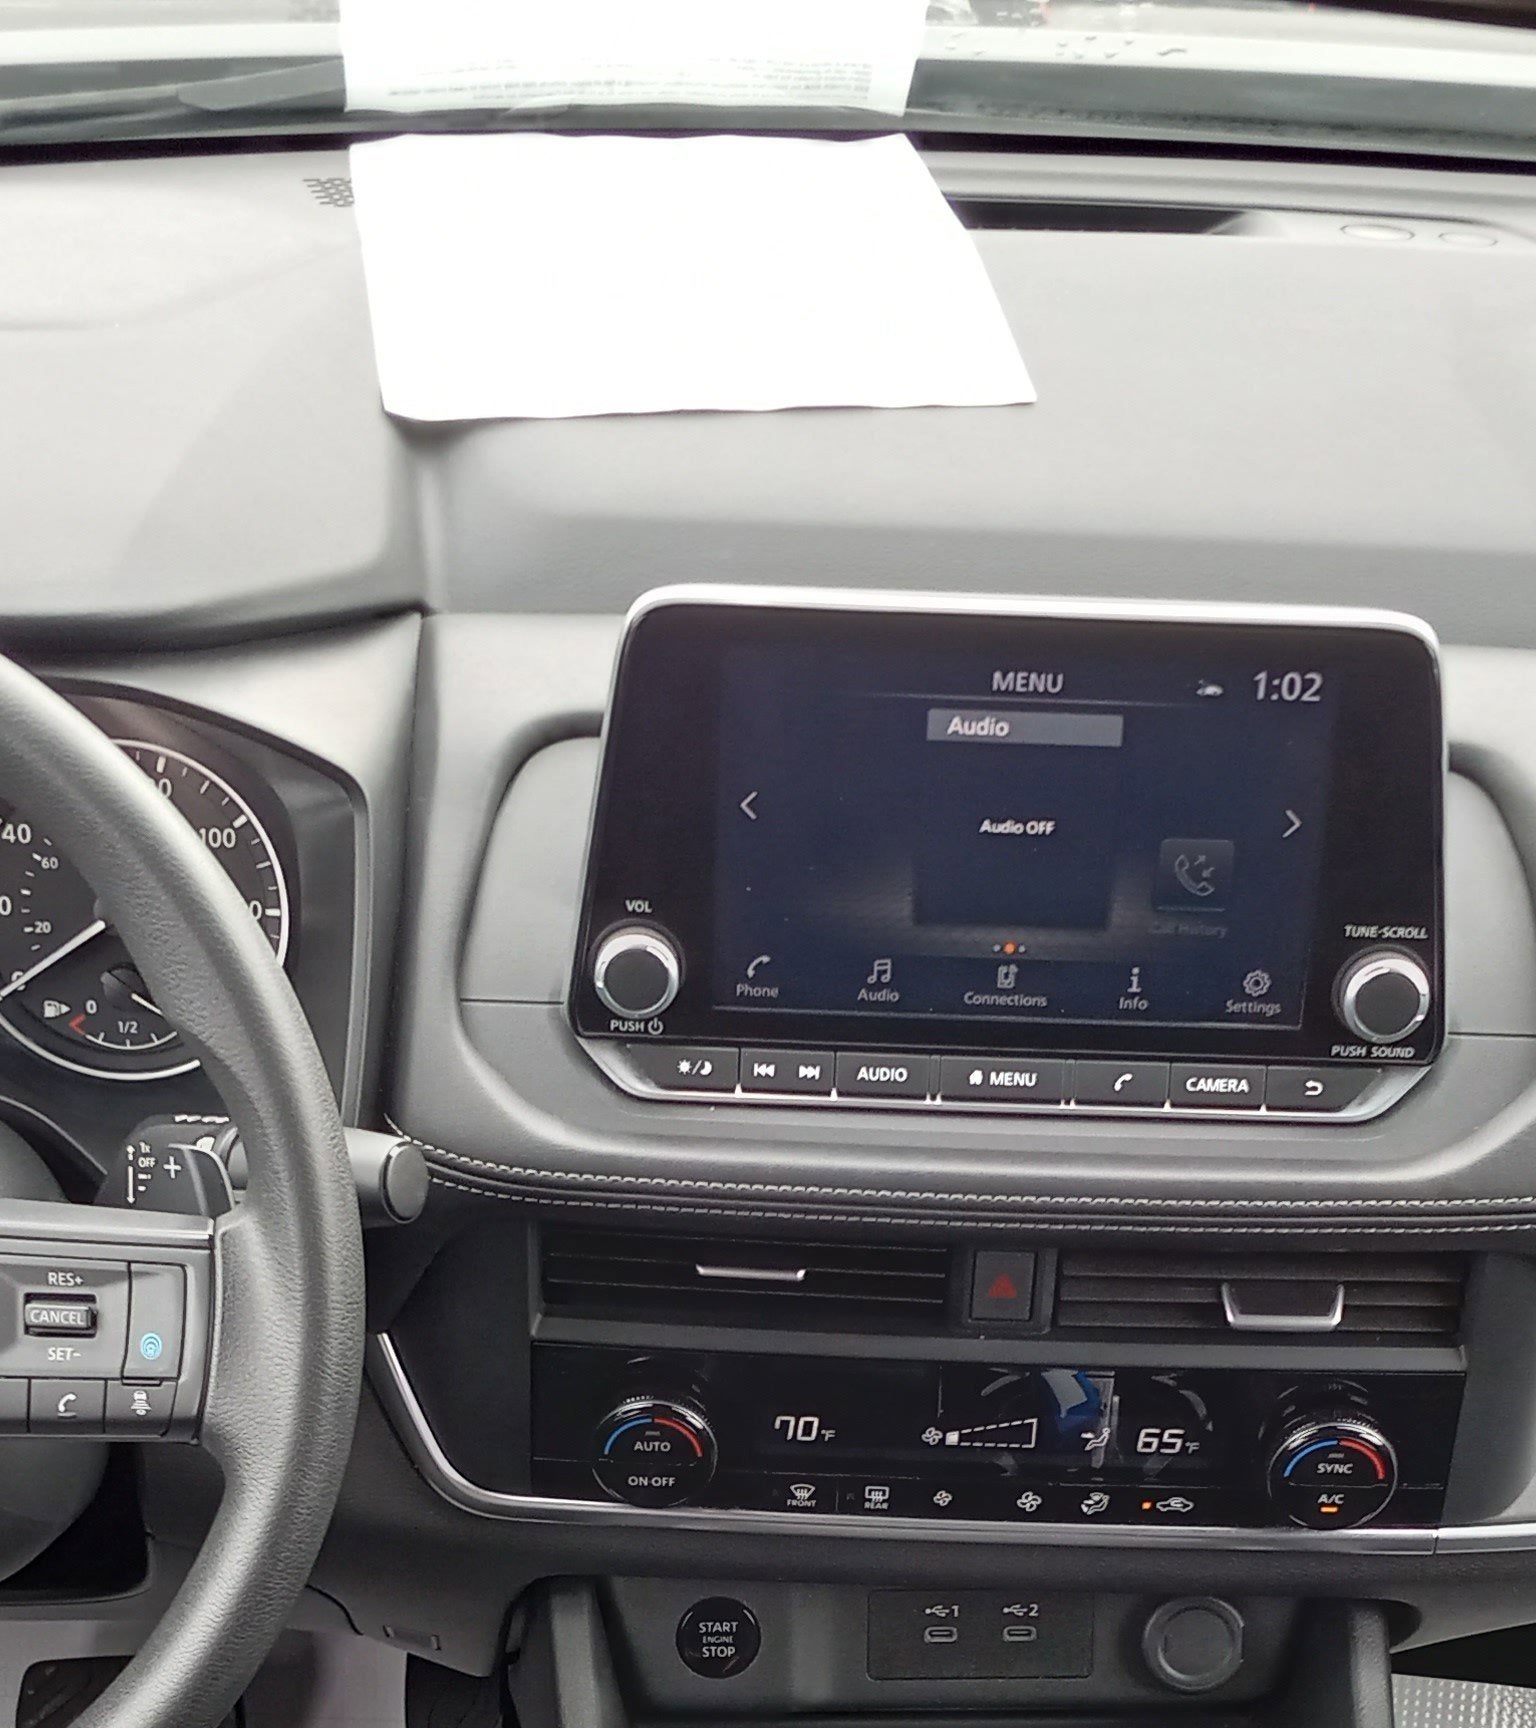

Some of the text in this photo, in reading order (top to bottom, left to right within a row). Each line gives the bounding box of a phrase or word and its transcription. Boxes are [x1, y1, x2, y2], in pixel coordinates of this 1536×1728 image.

[991, 670, 1064, 693] MENU
[1253, 671, 1323, 702] 1:02
[946, 716, 1010, 737] Audio
[1, 823, 31, 844] 40
[625, 900, 652, 913] VOL
[735, 983, 780, 998] Phone
[857, 987, 899, 1002] Audio
[964, 991, 1047, 1008] Connections
[1118, 996, 1149, 1011] Info
[1226, 999, 1282, 1015] Settings
[117, 1021, 138, 1034] 1/2
[610, 1019, 645, 1033] PUSH
[1331, 1044, 1415, 1059] PUSH SOUND
[856, 1066, 908, 1083] AUDIO
[989, 1070, 1038, 1088] MENU
[1185, 1076, 1250, 1094] CAMERA
[30, 1309, 85, 1325] CANCEL
[634, 1440, 671, 1453] AUTO
[1317, 1463, 1353, 1475] SYNC
[1318, 1493, 1344, 1504] A/C
[698, 1621, 738, 1633] START
[702, 1645, 736, 1658] STOP
